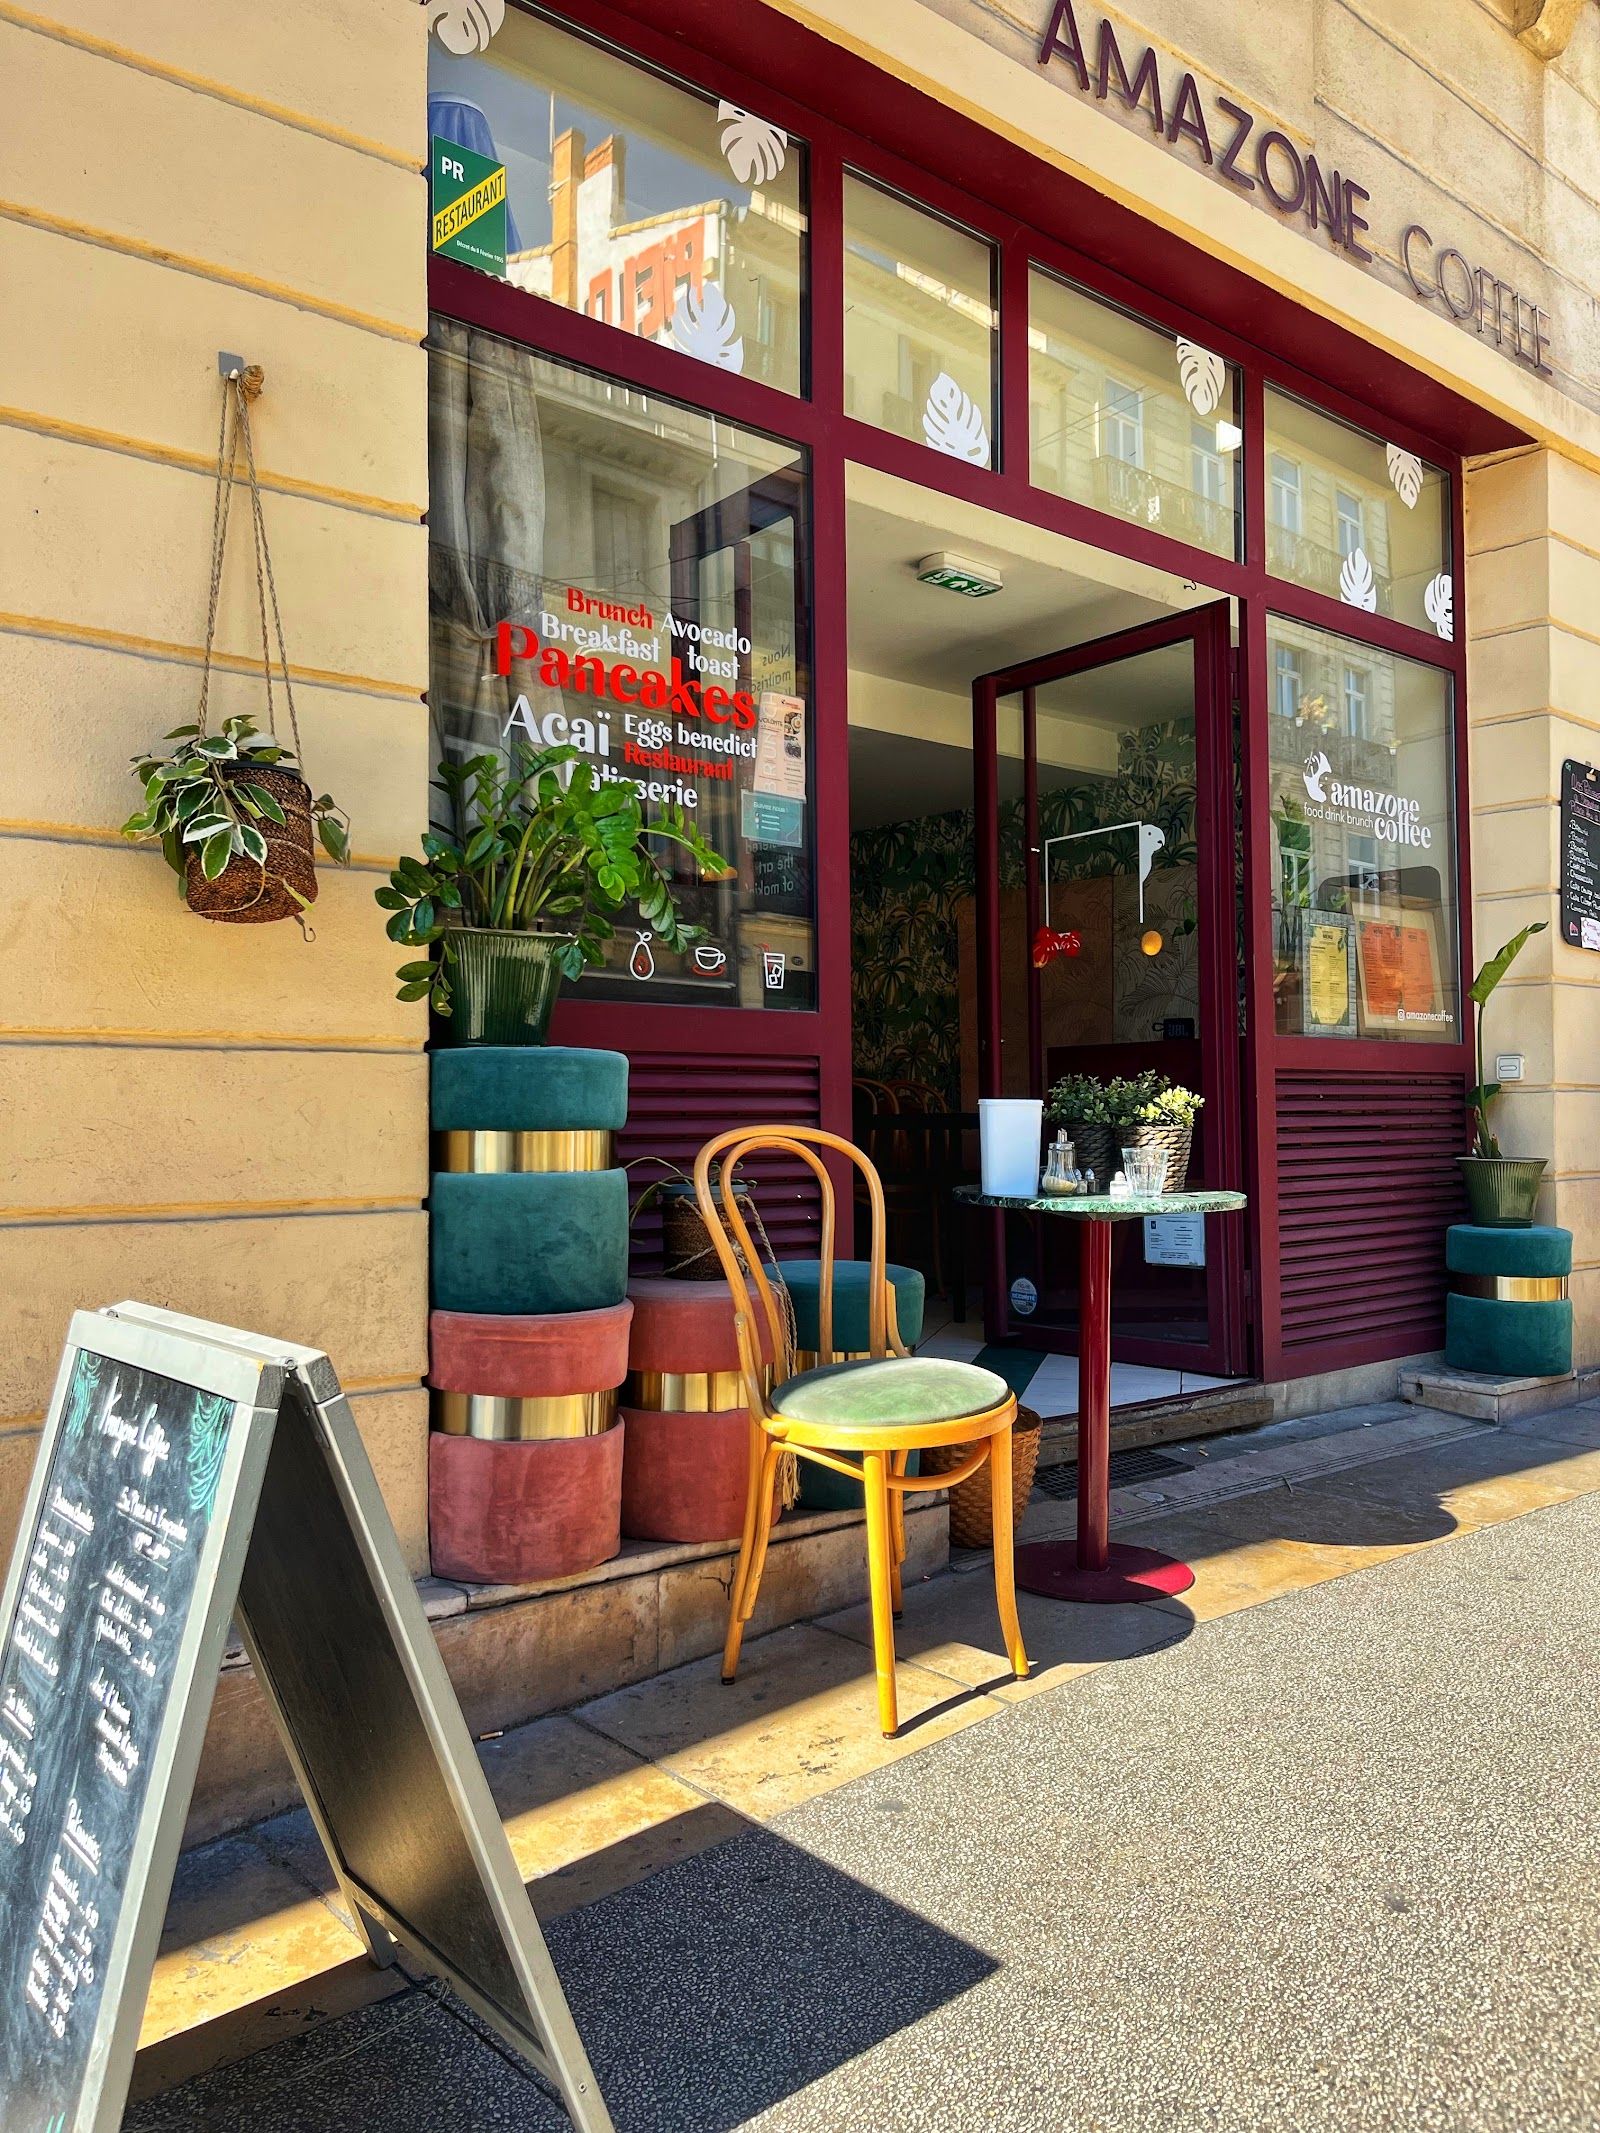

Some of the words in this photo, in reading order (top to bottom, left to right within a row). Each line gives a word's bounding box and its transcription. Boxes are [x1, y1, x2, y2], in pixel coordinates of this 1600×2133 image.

[441, 155, 465, 182] PR
[1038, 0, 1373, 263] AMAZONE
[1404, 225, 1554, 376] COFFEE
[436, 173, 503, 242] RESTAURANT
[567, 587, 653, 630] Brunch
[541, 611, 661, 663] Breakfast
[661, 611, 751, 655] Avocado
[496, 620, 757, 731] Pancakes
[687, 644, 741, 680] toast
[624, 713, 673, 749] Eggs
[678, 721, 758, 759] benedict
[624, 740, 734, 781] Restaurant
[1331, 782, 1420, 822] amazone
[1303, 802, 1324, 820] food
[1325, 808, 1345, 823] drink
[1346, 811, 1374, 829] brunch
[1374, 810, 1431, 849] coffee
